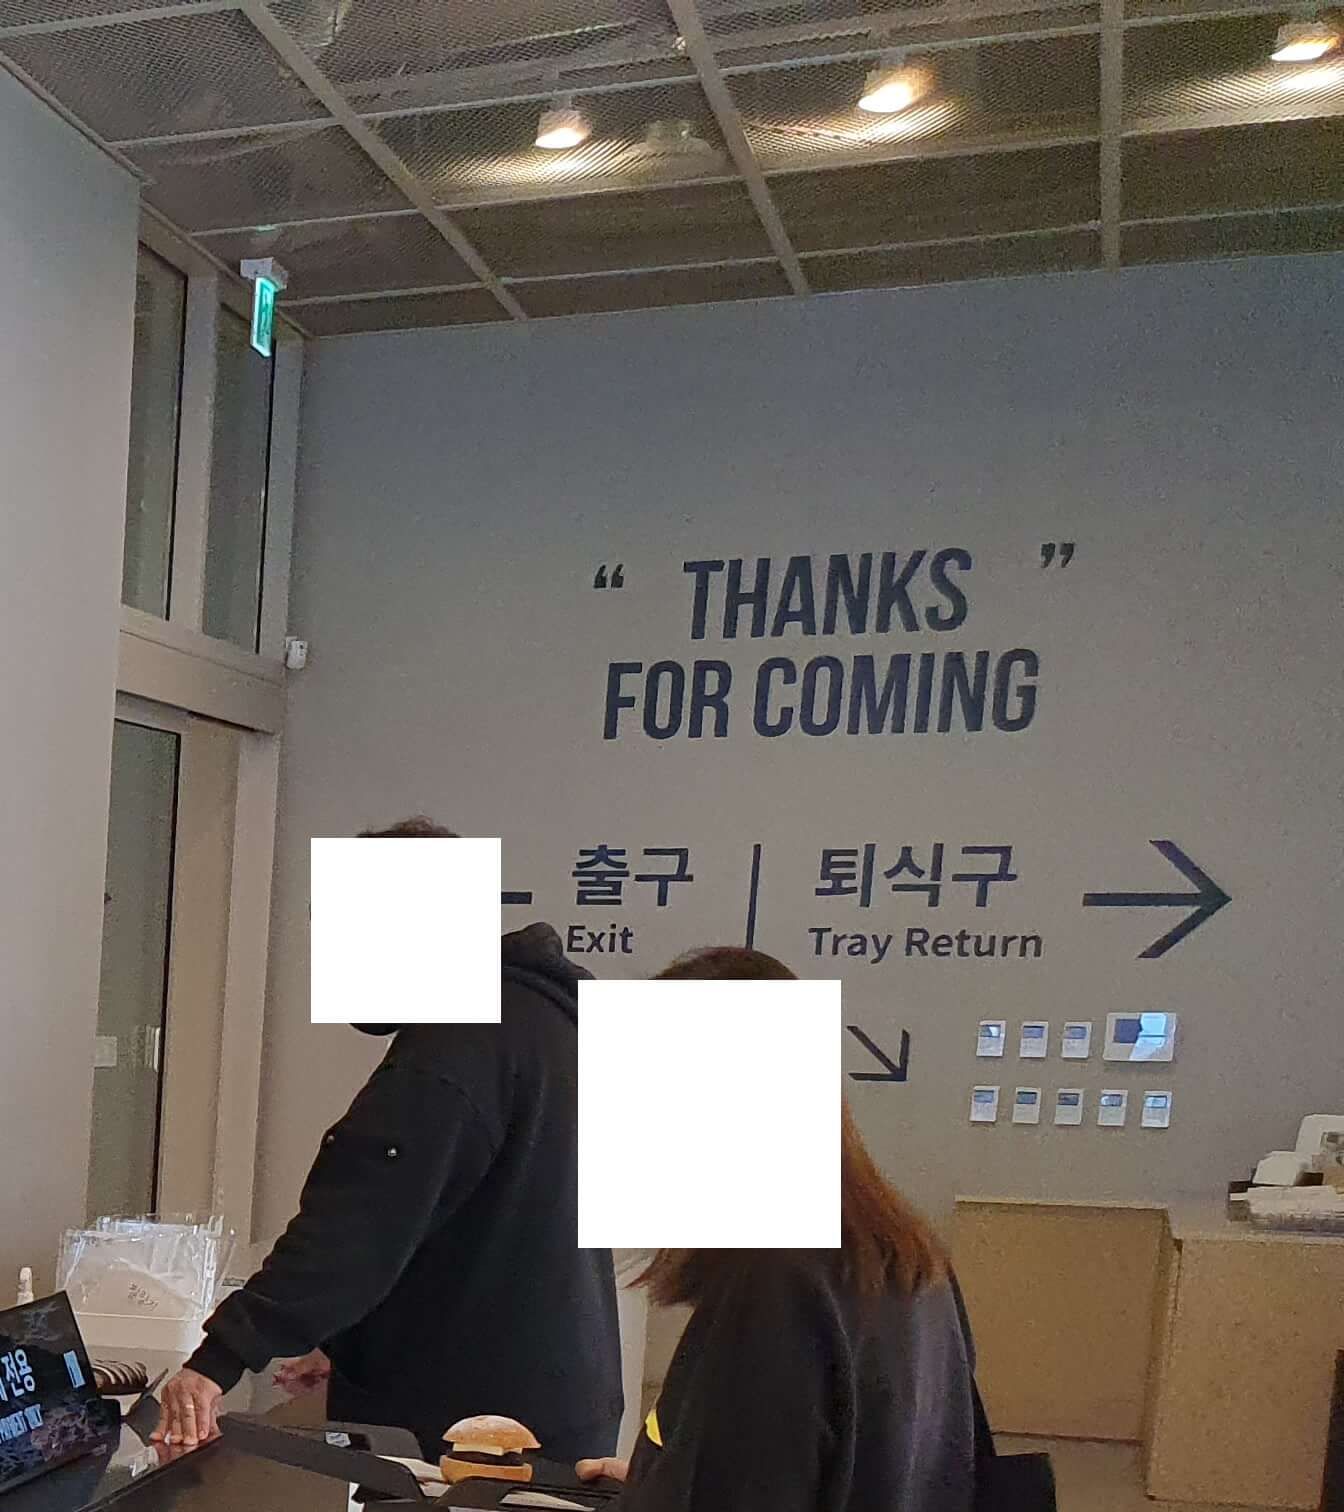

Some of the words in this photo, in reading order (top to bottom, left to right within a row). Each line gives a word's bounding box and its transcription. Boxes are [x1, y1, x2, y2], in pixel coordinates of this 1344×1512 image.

[683, 547, 973, 639] THANKS
[603, 659, 733, 740] FOR
[753, 648, 1040, 739] COMING
[571, 843, 695, 907] 출구
[814, 842, 1018, 908] 퇴식구
[565, 923, 634, 955] Exit
[808, 926, 895, 964] Tray
[904, 927, 1044, 959] Return
[0, 1348, 36, 1397] 전용
